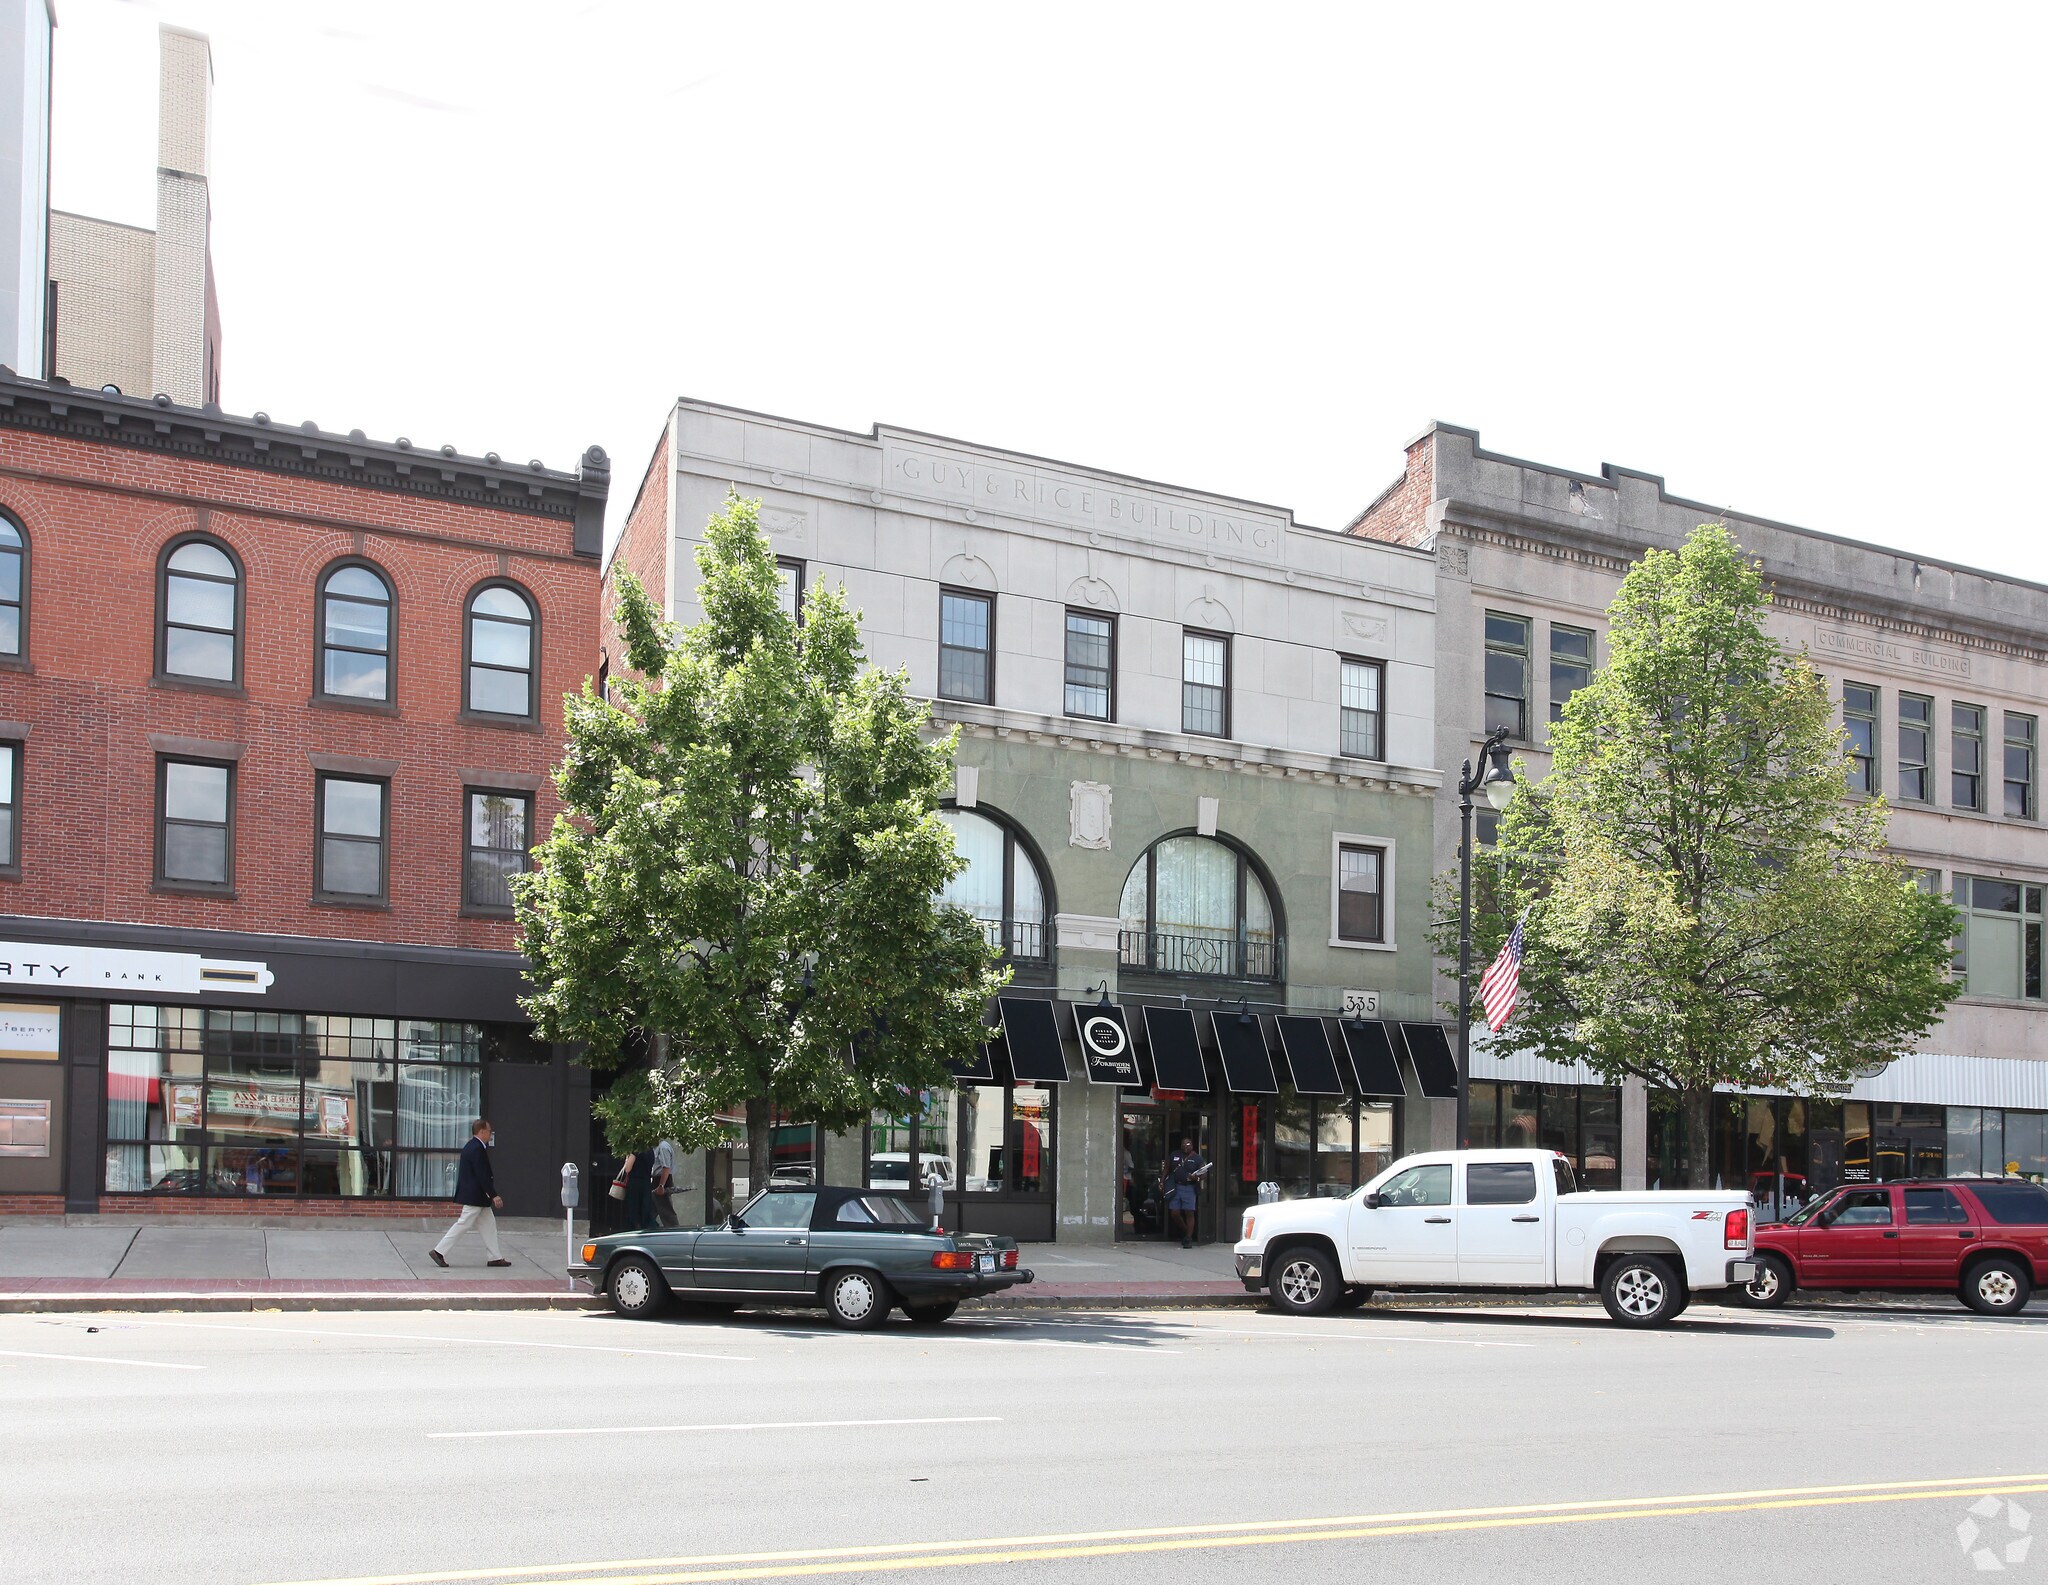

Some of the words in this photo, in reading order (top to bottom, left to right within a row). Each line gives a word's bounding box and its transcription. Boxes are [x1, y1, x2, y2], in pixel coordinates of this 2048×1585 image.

[902, 458, 972, 488] GUY
[986, 473, 1000, 494] &
[1014, 479, 1093, 514] RICE
[1110, 498, 1267, 548] BUILDING
[1819, 633, 1901, 660] COMMERCIAL
[1912, 651, 1968, 673] BUILDING
[105, 971, 162, 982] BANK
[1346, 995, 1376, 1012] 335
